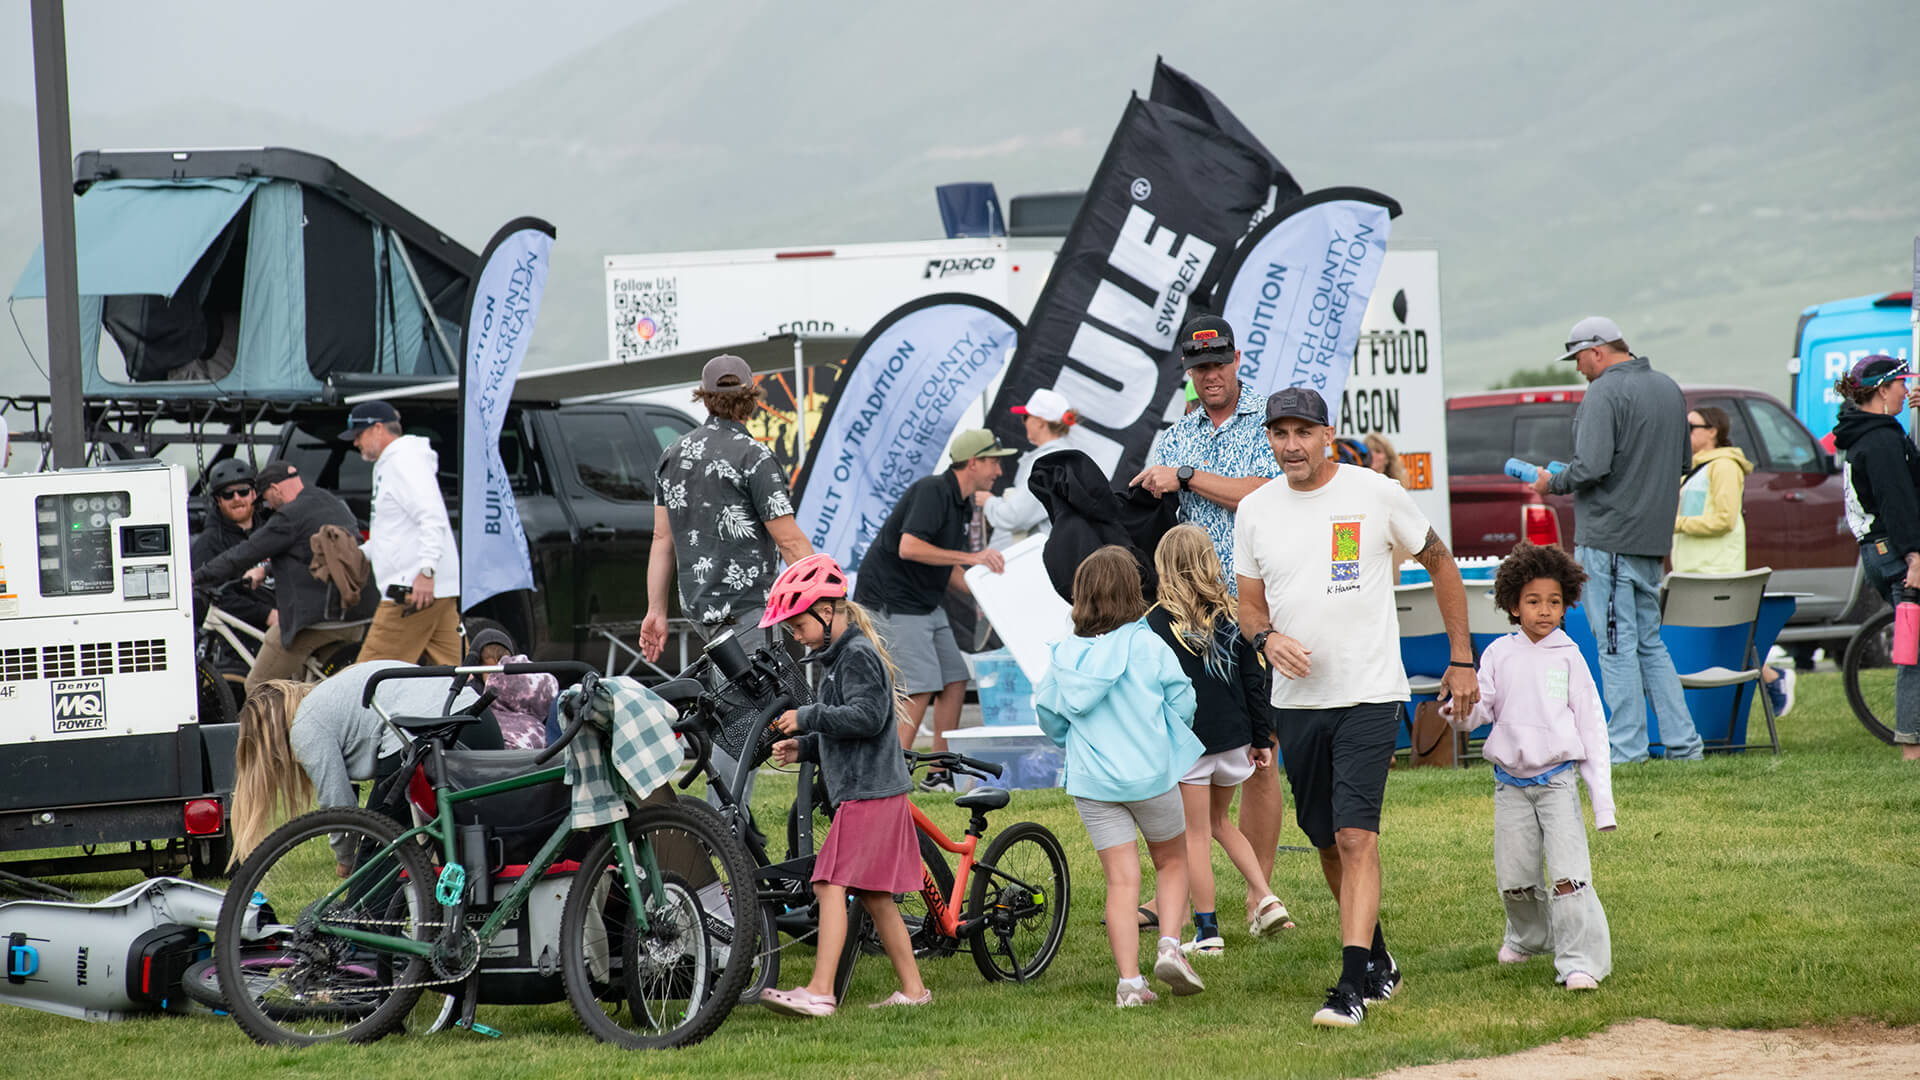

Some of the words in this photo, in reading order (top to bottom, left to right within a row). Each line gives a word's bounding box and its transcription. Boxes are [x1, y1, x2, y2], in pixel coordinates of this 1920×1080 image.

[613, 277, 653, 292] Follow
[656, 276, 677, 291] Us!
[1155, 252, 1201, 337] SWEDEN
[1308, 229, 1349, 327] COUNTY
[1315, 222, 1375, 368] RECREATION
[1370, 329, 1428, 376] FOOD
[843, 339, 916, 448] TRADITION
[913, 335, 1001, 448] RECREATION
[1311, 371, 1328, 390] &
[868, 410, 921, 501] WASATCH
[914, 331, 975, 414] COUNTY
[1336, 387, 1401, 436] AGON
[833, 450, 855, 483] ON
[905, 449, 924, 467] &
[811, 485, 844, 550] BUILT
[55, 694, 104, 718] MQ
[56, 681, 100, 691] Denyo
[56, 718, 103, 730] POWER
[77, 946, 89, 987] THULE
